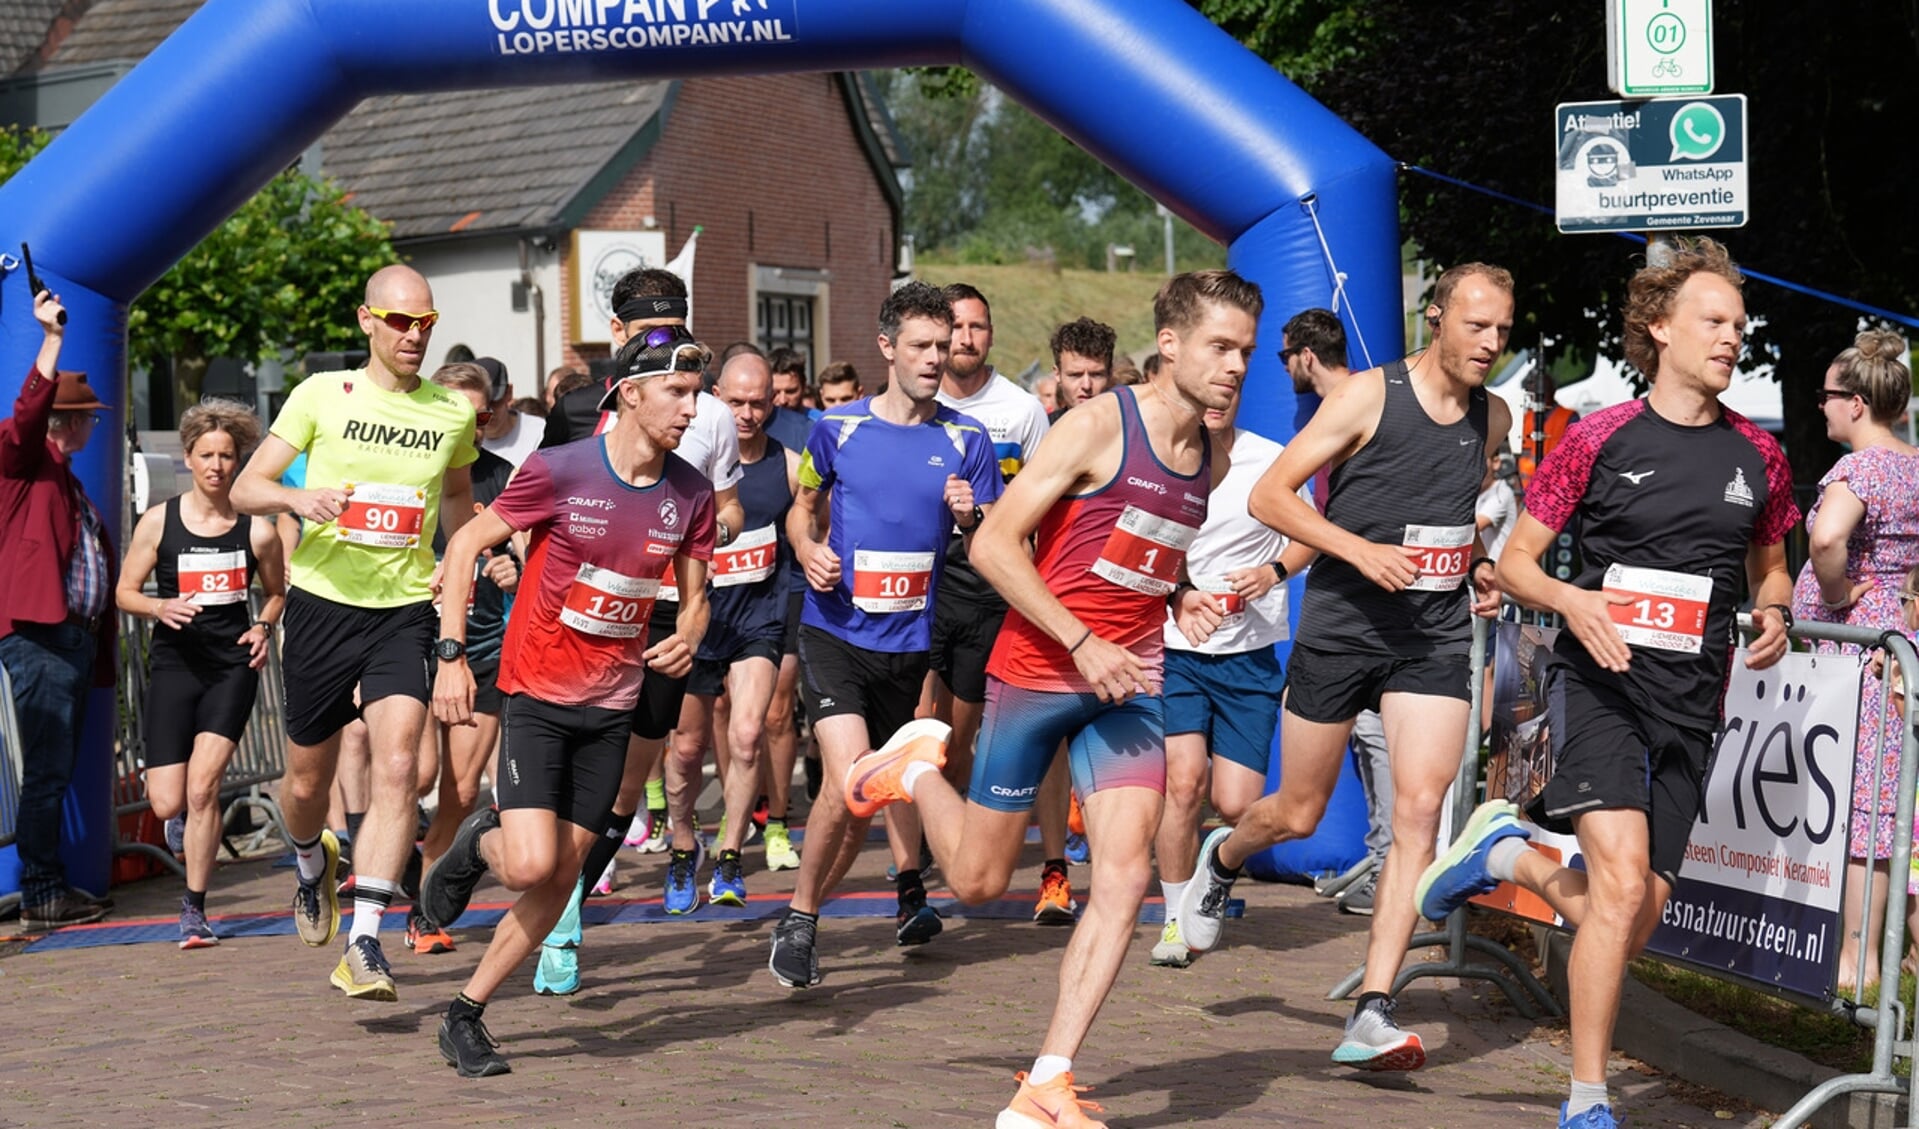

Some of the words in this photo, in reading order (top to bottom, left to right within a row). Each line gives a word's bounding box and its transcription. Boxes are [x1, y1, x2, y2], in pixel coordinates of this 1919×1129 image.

[498, 19, 791, 55] LOPERSCOMPANY.NL
[1654, 25, 1678, 43] 01
[1564, 111, 1641, 132] Attie!
[1662, 167, 1734, 182] WhatsApp
[1599, 187, 1734, 211] buurtpreventie
[1646, 216, 1691, 226] Gemeente
[1694, 215, 1736, 224] Zevenaar
[1127, 476, 1161, 492] CRAFT
[567, 496, 606, 509] CRAFT
[365, 507, 399, 531] 90
[726, 549, 766, 572] 117
[1138, 548, 1159, 574] 1
[1420, 551, 1462, 575] 103
[202, 573, 229, 592] 82
[880, 576, 910, 597] 10
[584, 595, 638, 622] 120
[1632, 599, 1676, 629] 13
[990, 784, 1036, 797] CRAFT
[1783, 854, 1832, 889] Keramiek
